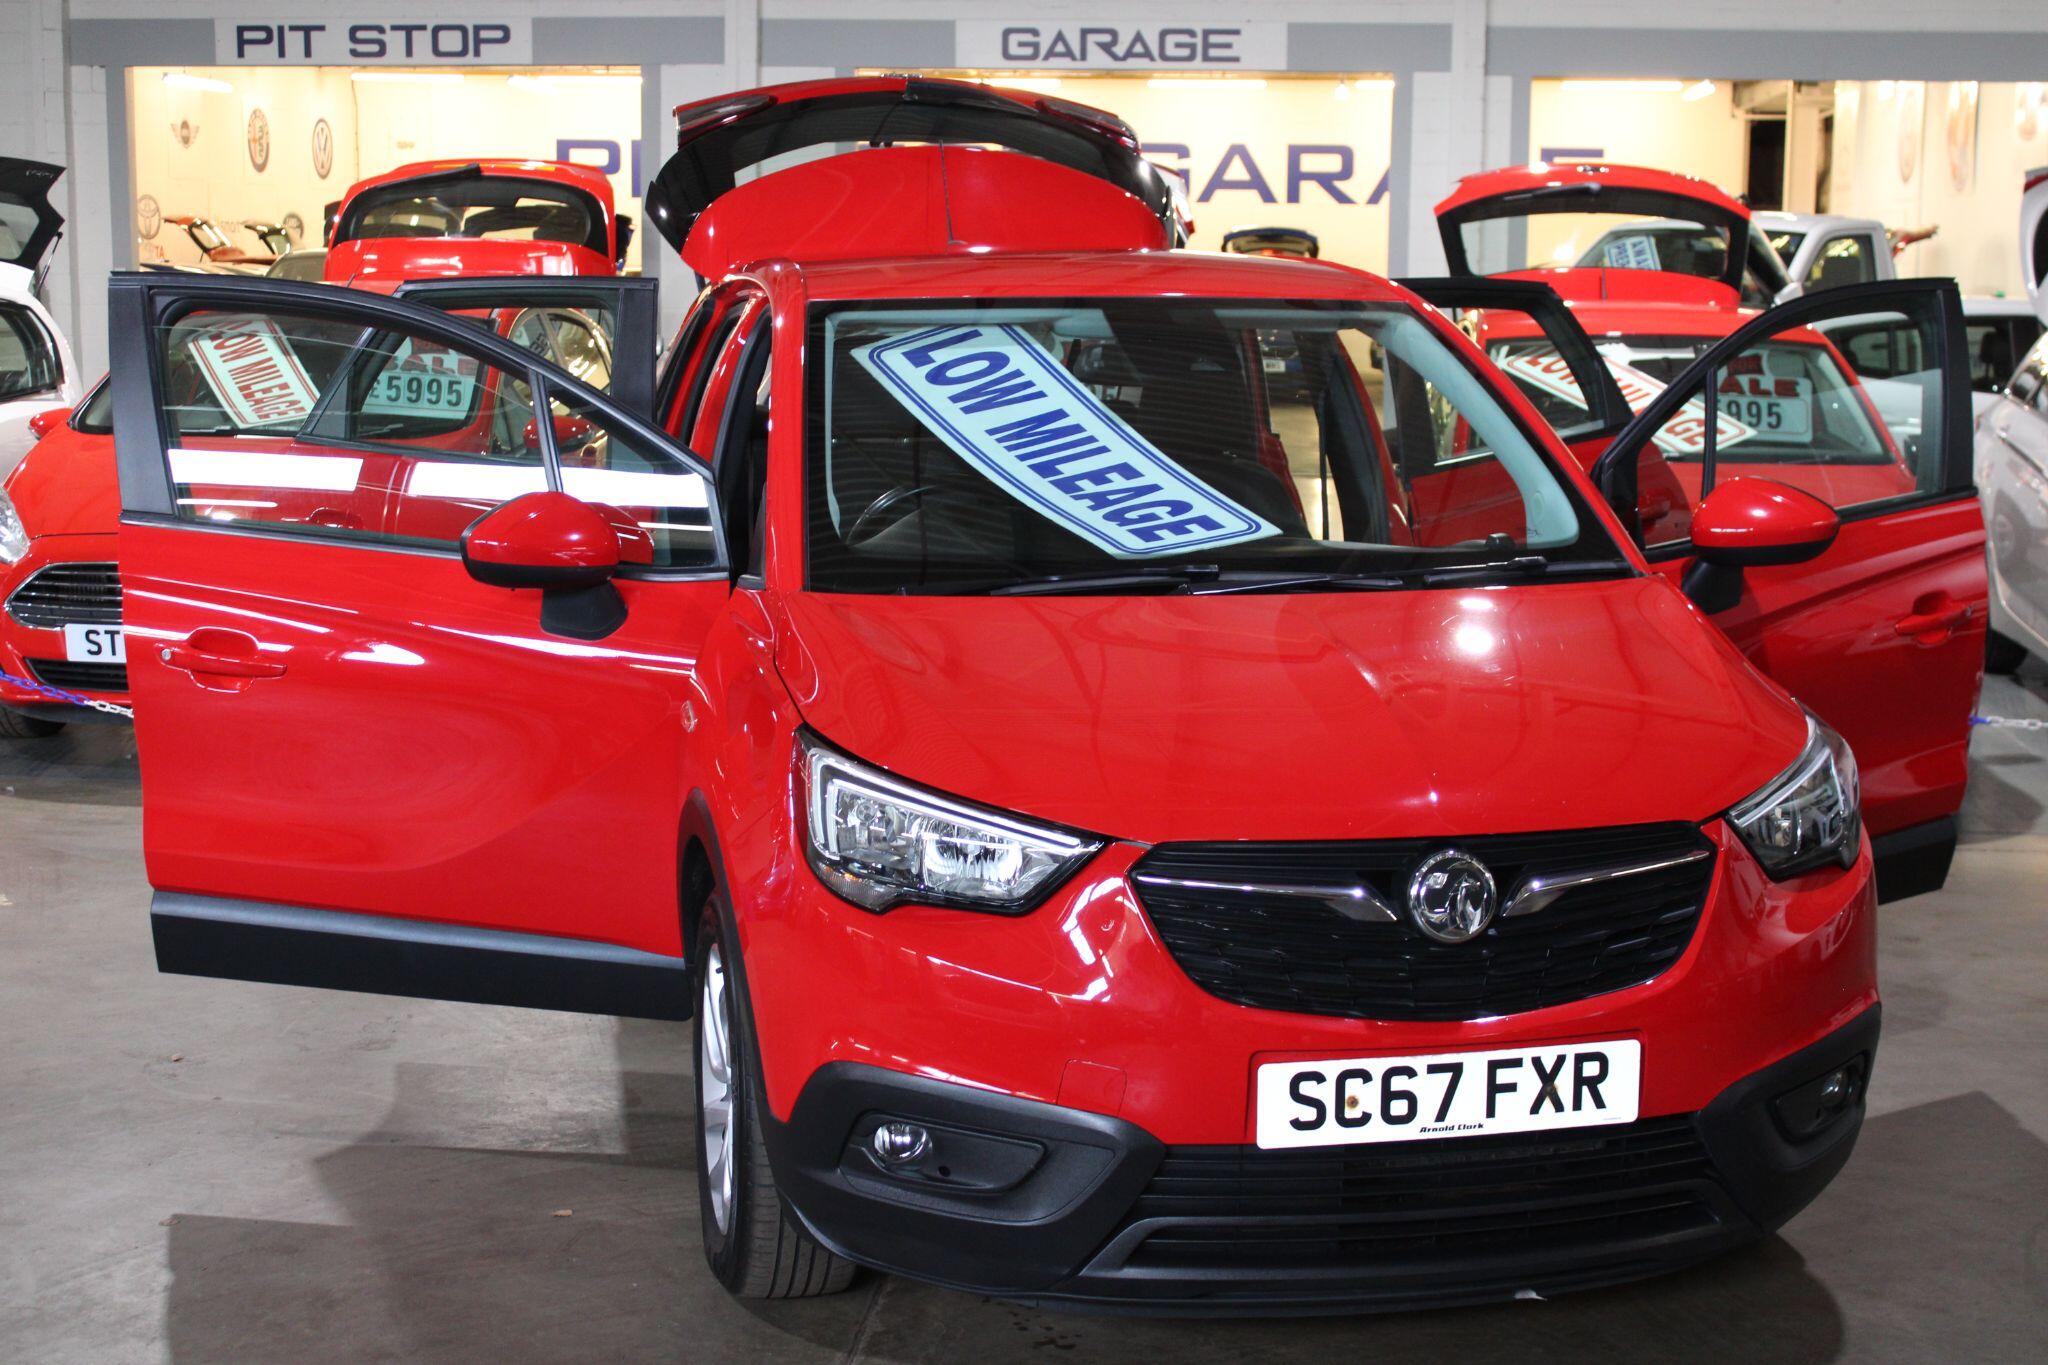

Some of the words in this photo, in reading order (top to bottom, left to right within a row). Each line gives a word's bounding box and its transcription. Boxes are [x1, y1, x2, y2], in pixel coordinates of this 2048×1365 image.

[236, 25, 326, 58] PIT
[349, 24, 511, 58] STOP
[1001, 27, 1242, 63] GARAGE
[228, 356, 307, 420] MILEAGE
[1717, 375, 1800, 397] ALE
[900, 329, 1049, 415] LOW
[984, 408, 1226, 544] MILEAGE
[1288, 1061, 1464, 1132] SC67
[1485, 1051, 1609, 1119] FXR
[1419, 1124, 1455, 1134] Arnold
[1457, 1122, 1485, 1131] Clark
